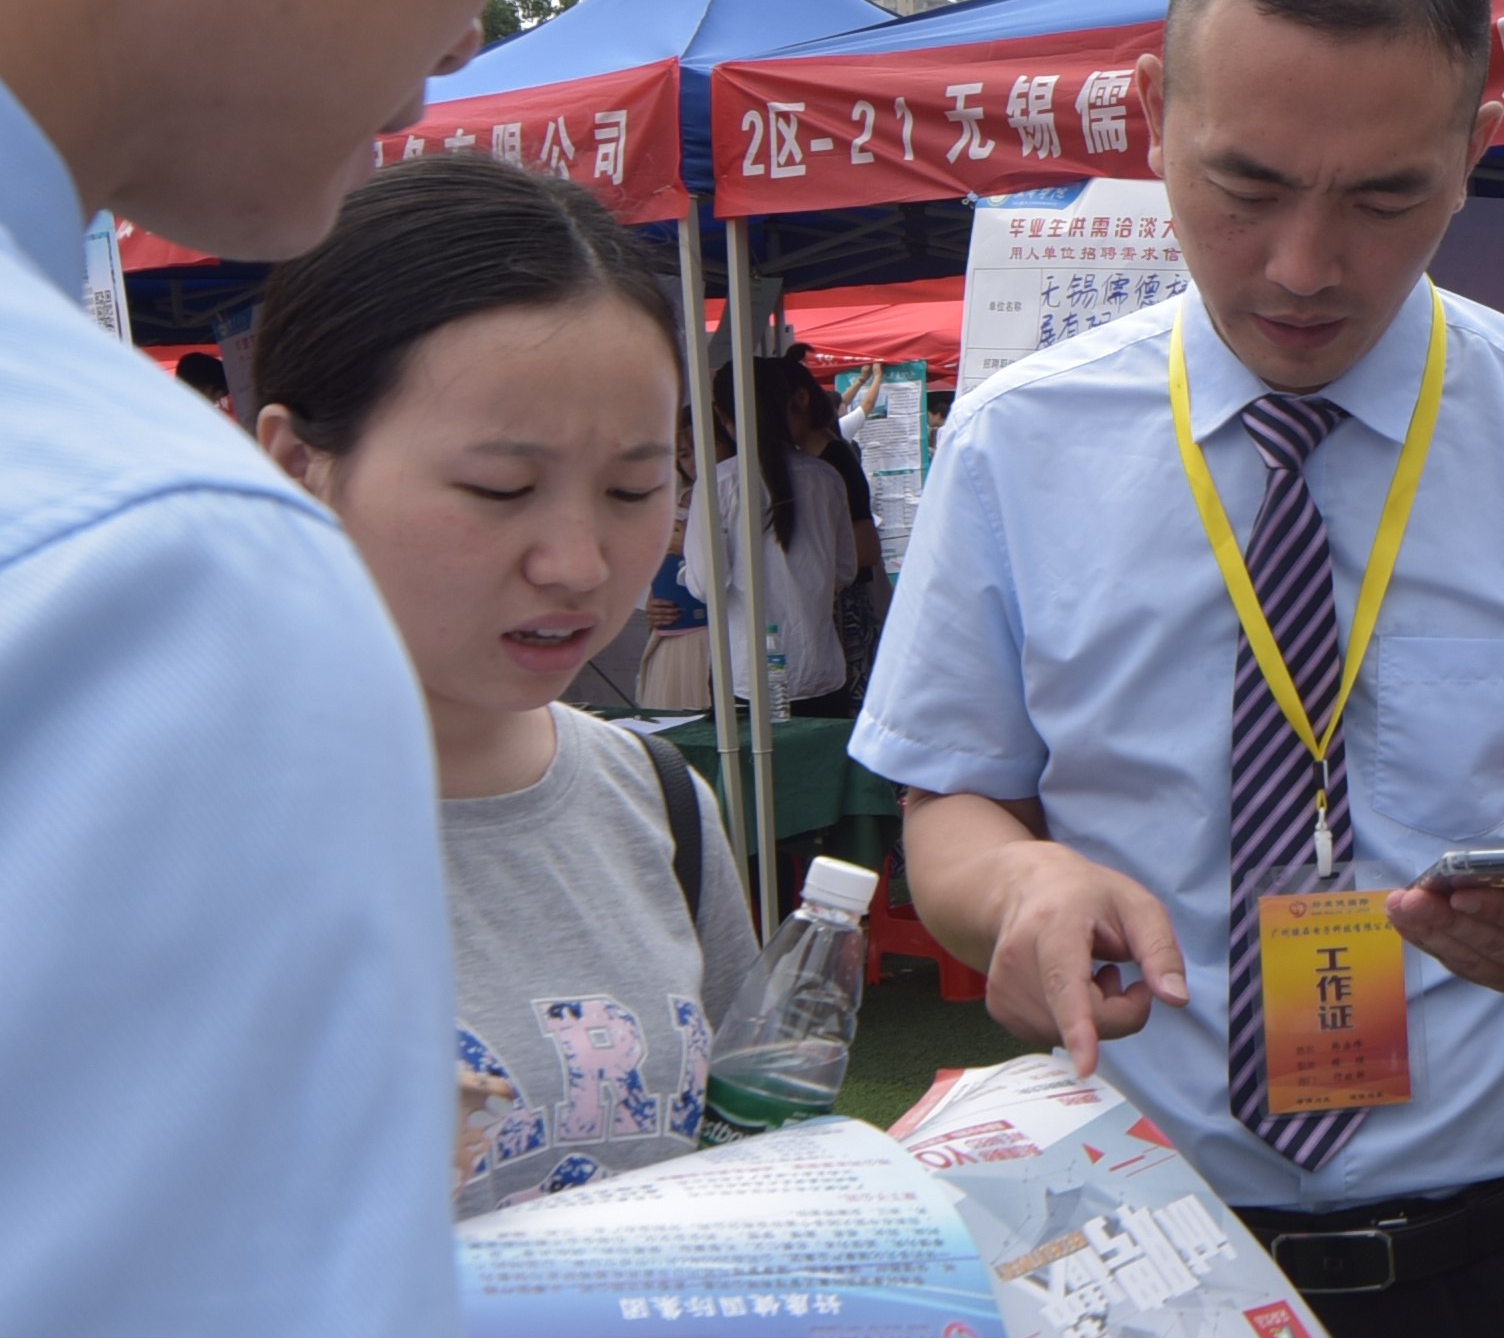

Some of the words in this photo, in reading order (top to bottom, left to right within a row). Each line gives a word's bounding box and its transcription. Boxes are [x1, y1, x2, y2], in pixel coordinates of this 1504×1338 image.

[989, 301, 1022, 311] 单位名称
[1315, 946, 1354, 1031] 工作证
